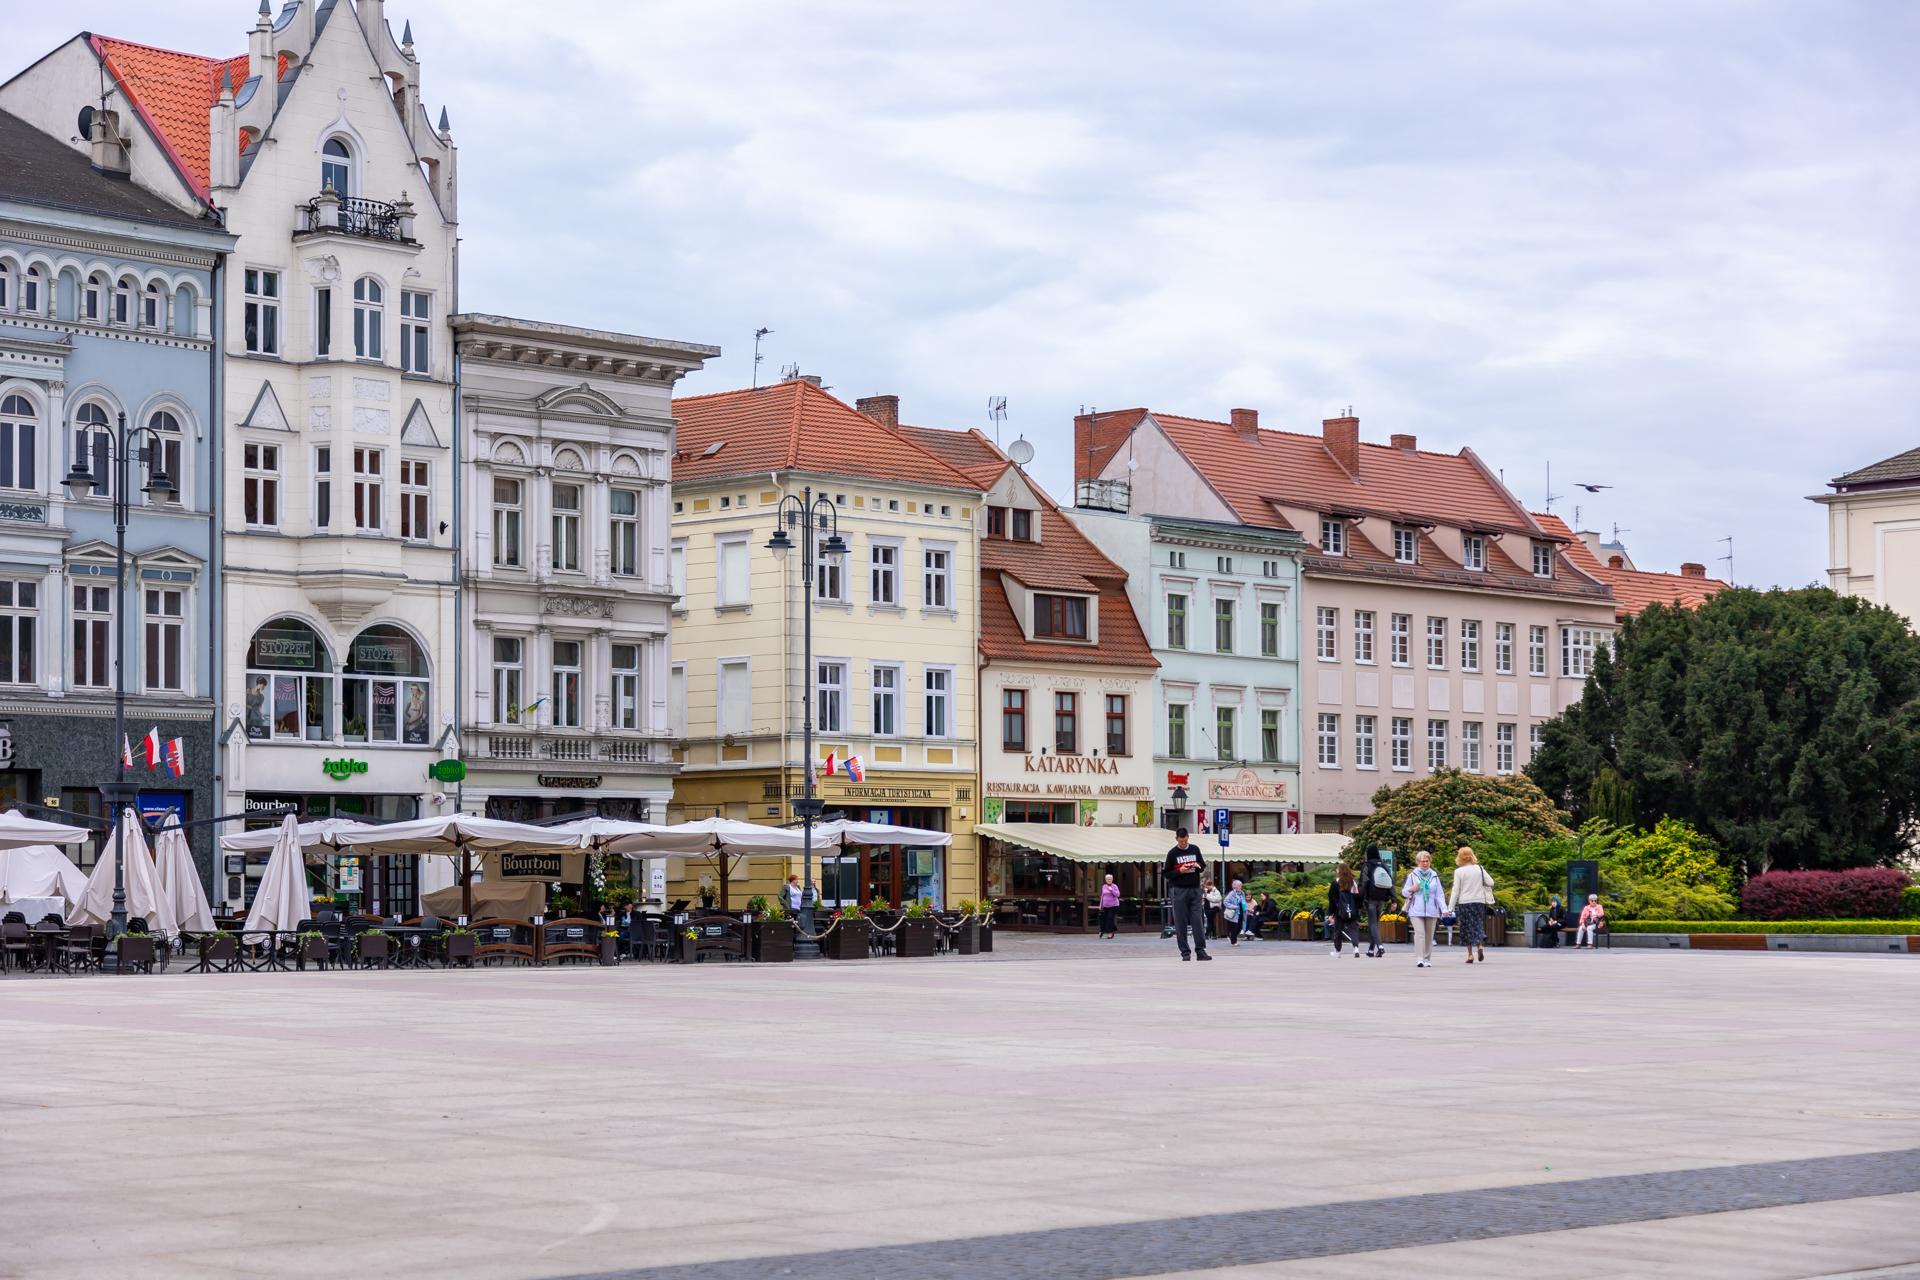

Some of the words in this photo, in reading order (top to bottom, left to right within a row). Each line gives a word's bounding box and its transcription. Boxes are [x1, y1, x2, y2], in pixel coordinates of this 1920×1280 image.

[323, 758, 368, 775] żabka
[1024, 755, 1119, 775] KATARYNKA
[844, 787, 886, 797] INFORMACJA
[888, 788, 931, 798] TURYSTYCZNA
[986, 782, 1040, 793] RESTAURACJA
[1046, 784, 1092, 795] KAWIARNIA
[1099, 785, 1151, 796] APARTAMENTY
[1218, 810, 1227, 823] P
[503, 856, 560, 870] Bourbon
